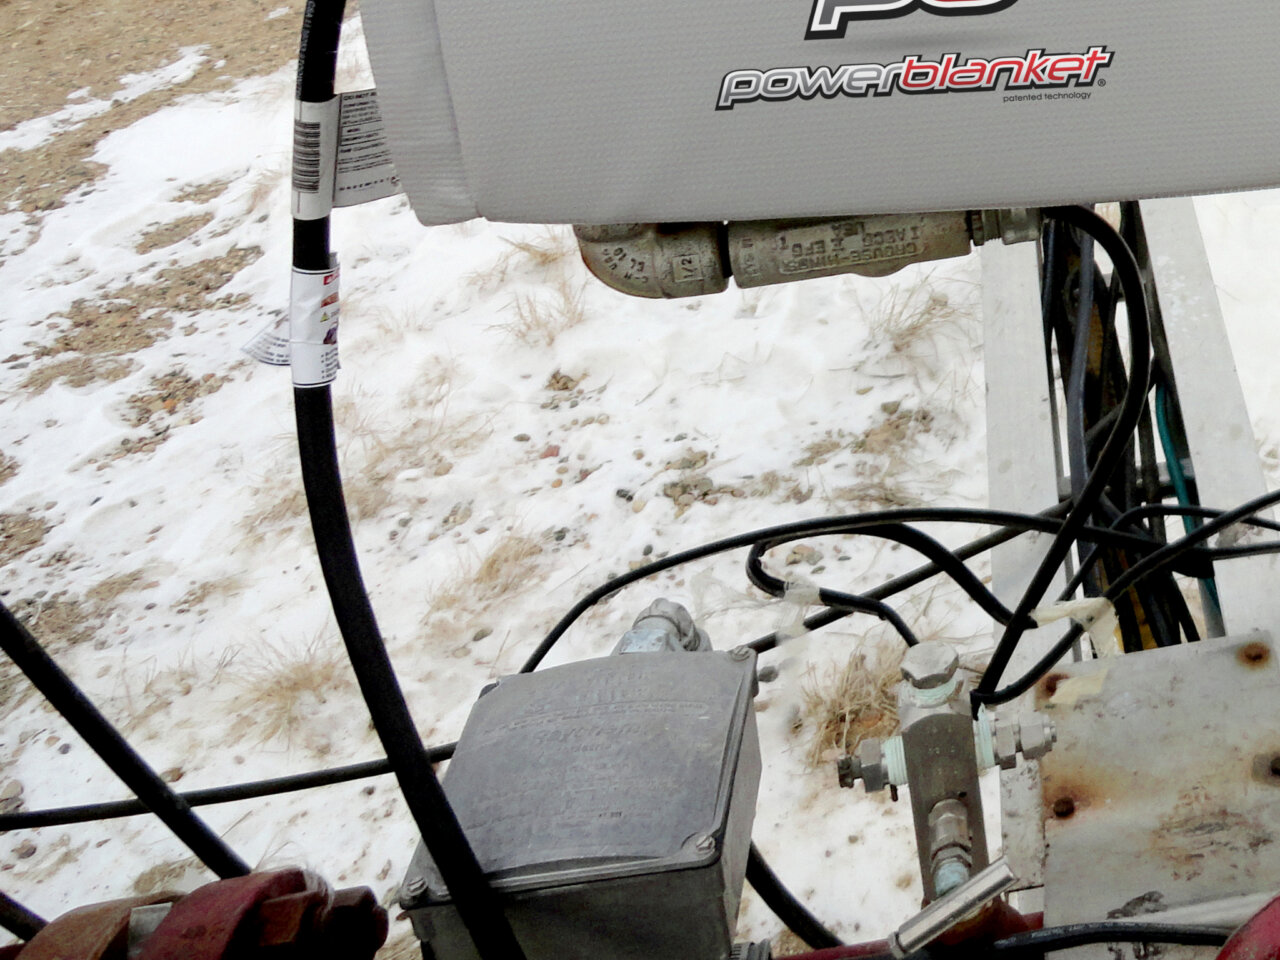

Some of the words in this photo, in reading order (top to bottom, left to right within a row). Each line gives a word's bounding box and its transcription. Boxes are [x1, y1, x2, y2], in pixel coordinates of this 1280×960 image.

[1003, 92, 1043, 104] patented
[1044, 90, 1092, 102] technology
[680, 256, 699, 280] 1/2
